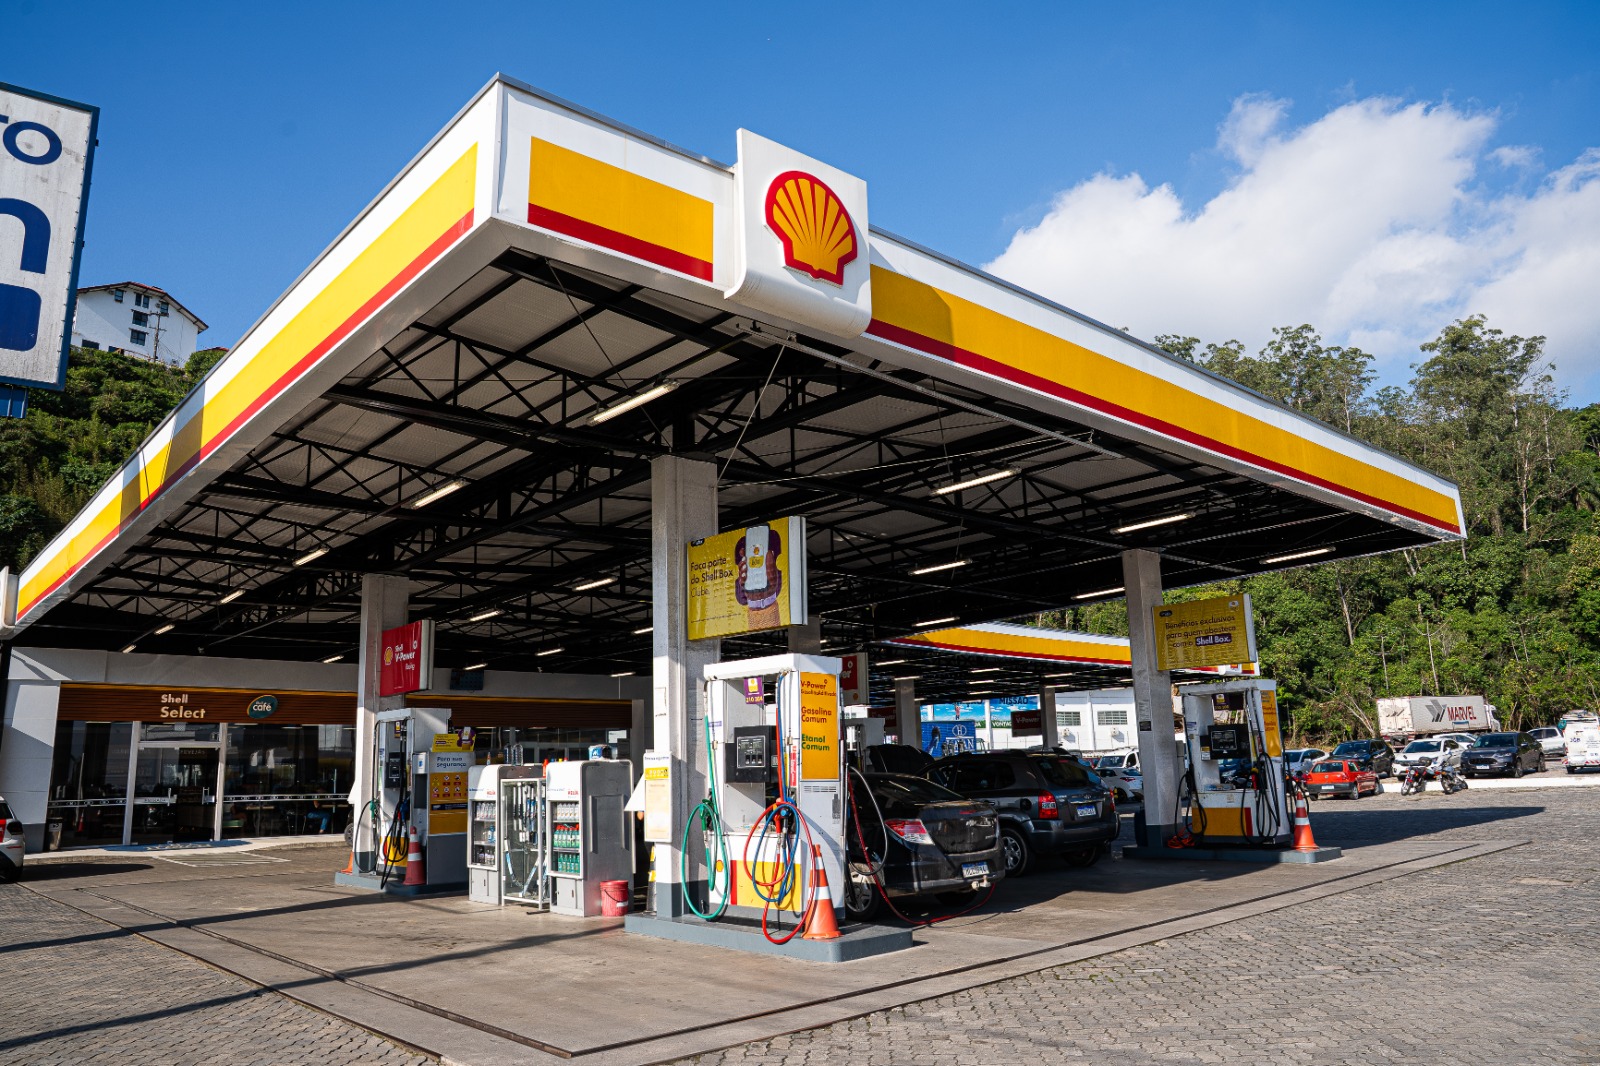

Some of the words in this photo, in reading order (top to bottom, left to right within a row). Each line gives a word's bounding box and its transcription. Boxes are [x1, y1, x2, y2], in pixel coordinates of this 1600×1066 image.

[0, 113, 62, 165] O
[691, 561, 706, 572] Faça
[708, 557, 727, 570] parte
[691, 574, 700, 585] do
[702, 569, 718, 583] Shell
[720, 569, 734, 579] Box
[1200, 615, 1236, 626] exclusivos
[1166, 631, 1182, 640] para
[1184, 629, 1203, 639] quem
[1196, 636, 1213, 645] Shell
[395, 651, 415, 662] V-Power
[800, 680, 826, 690] V-Power
[161, 694, 188, 704] Shell
[252, 702, 272, 711] café
[801, 706, 832, 716] Gasolina
[160, 705, 206, 719] Select
[1447, 706, 1476, 721] MARVEL
[801, 714, 828, 723] Comum
[801, 734, 826, 744] Etanol
[801, 742, 830, 751] Comum
